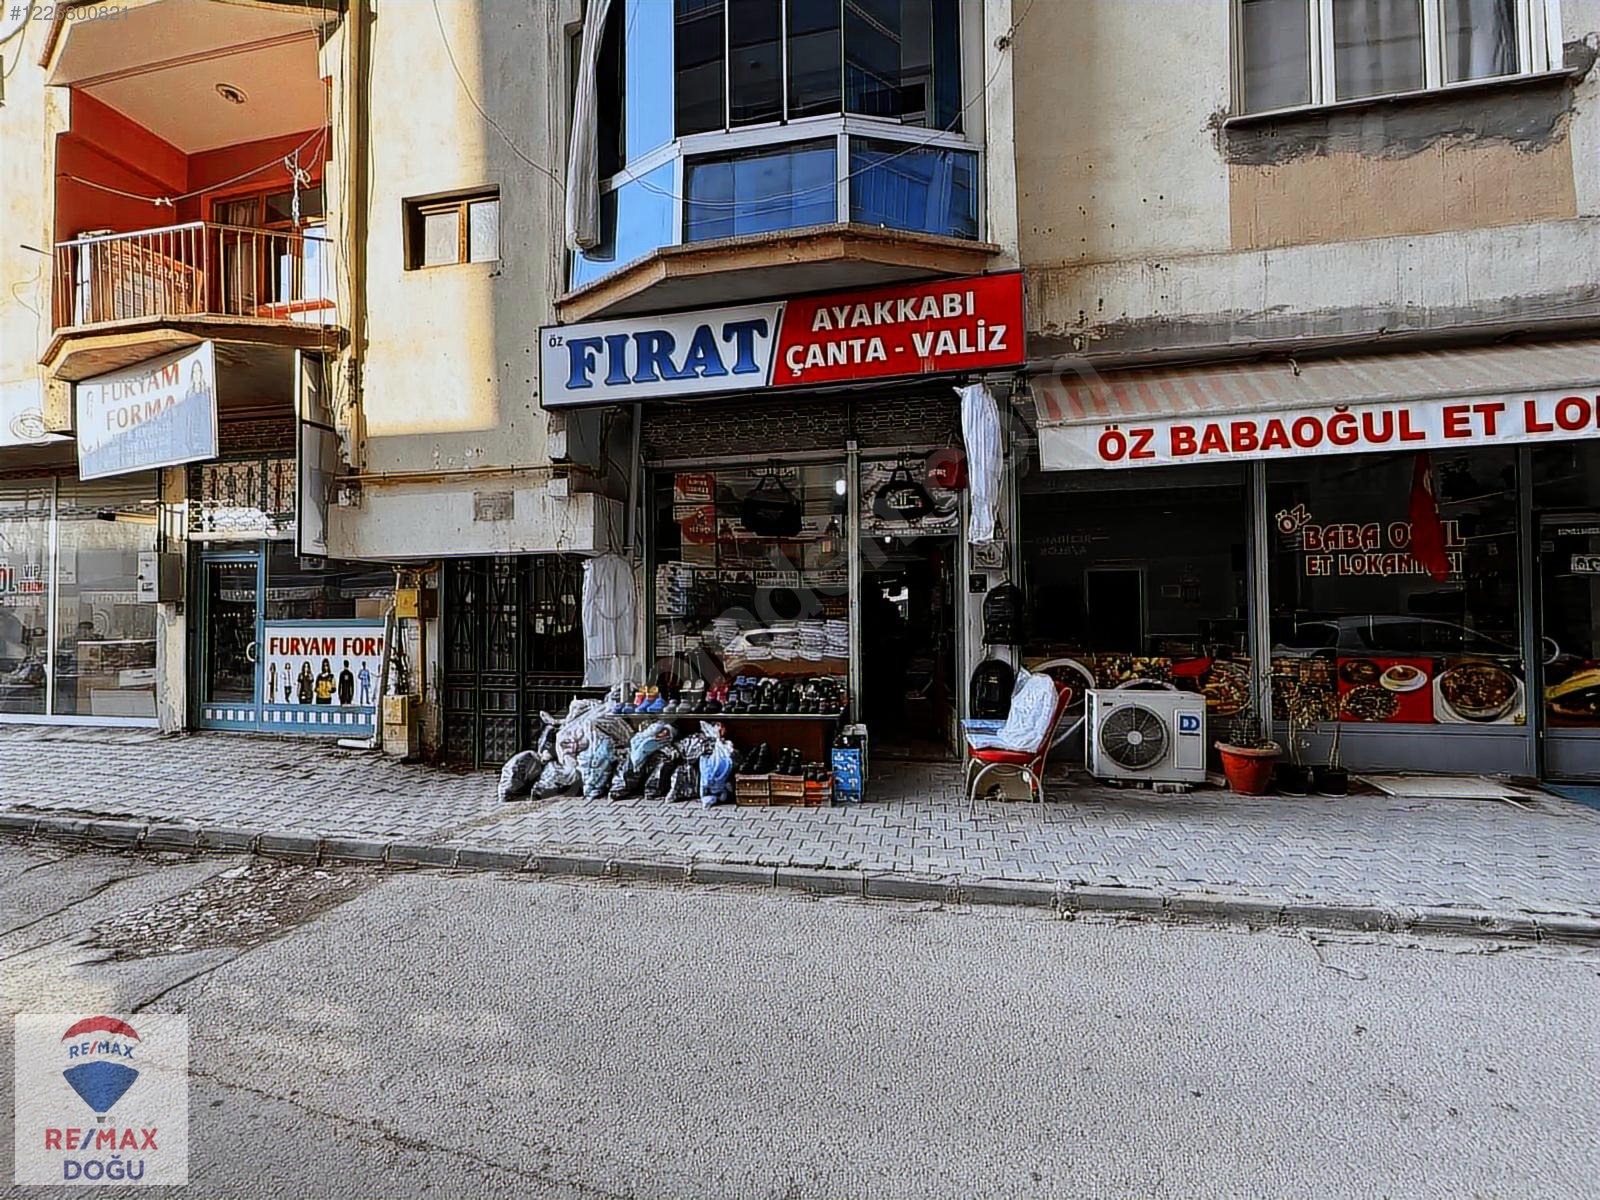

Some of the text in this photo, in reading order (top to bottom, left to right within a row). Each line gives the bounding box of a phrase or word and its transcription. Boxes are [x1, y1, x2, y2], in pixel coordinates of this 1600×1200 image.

[811, 290, 975, 332] AYAKKABI
[548, 333, 564, 348] ÖZ
[565, 317, 769, 390] FIRAT
[785, 336, 888, 377] ÇANTA
[911, 318, 1008, 358] VALİZ
[101, 361, 180, 405] FURYAM
[105, 394, 176, 432] FORMA
[1097, 395, 1600, 462] ÖZ BABAOĞUL ET LO
[1275, 503, 1312, 534] ÖZ
[1303, 519, 1467, 553] BABA OL
[1305, 551, 1463, 577] ET LOKANI
[269, 636, 336, 656] FURYAM
